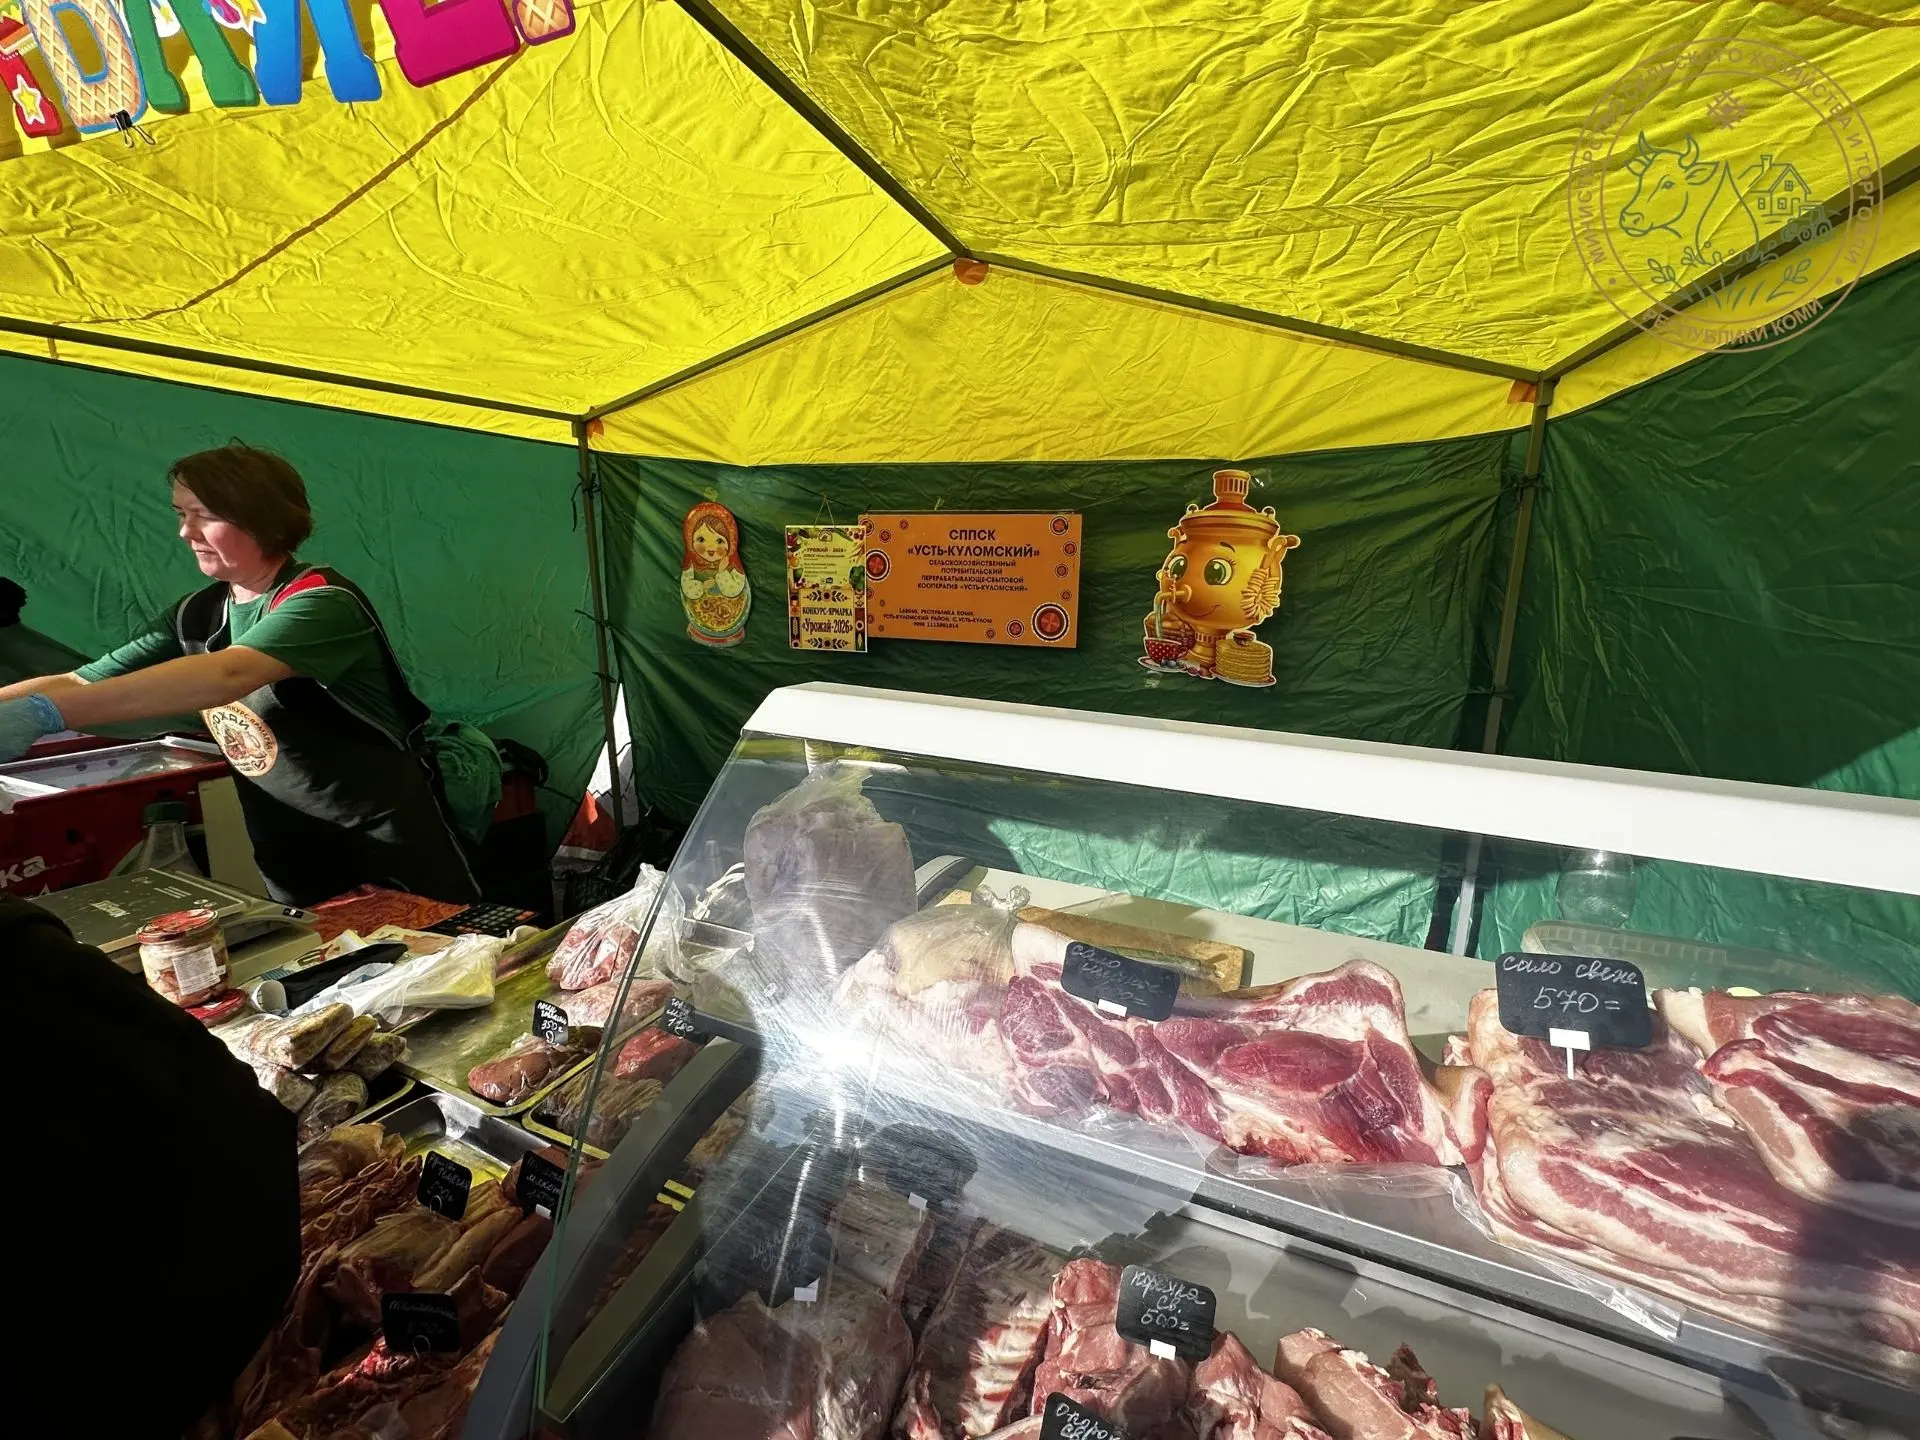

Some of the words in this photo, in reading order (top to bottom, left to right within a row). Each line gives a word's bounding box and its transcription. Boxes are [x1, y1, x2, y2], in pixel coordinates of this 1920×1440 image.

[949, 529, 996, 541] СППСК
[908, 544, 1040, 558] «УСТЬ-КУЛОМСКИЙ»
[929, 559, 1016, 567] СЕЛЬСКОХОЗЯЙСТВЕННЫЙ
[941, 567, 1003, 575] ПОТРЕБИТЕЛЬСКИЙ
[922, 575, 1024, 584] ПЕРЕРАБАТЫВАЮЩЕ-СБЫТОВОЙ
[802, 607, 853, 616] КОНКУРС-ЯРМАРКА
[802, 618, 853, 635] «Урожай-2026»
